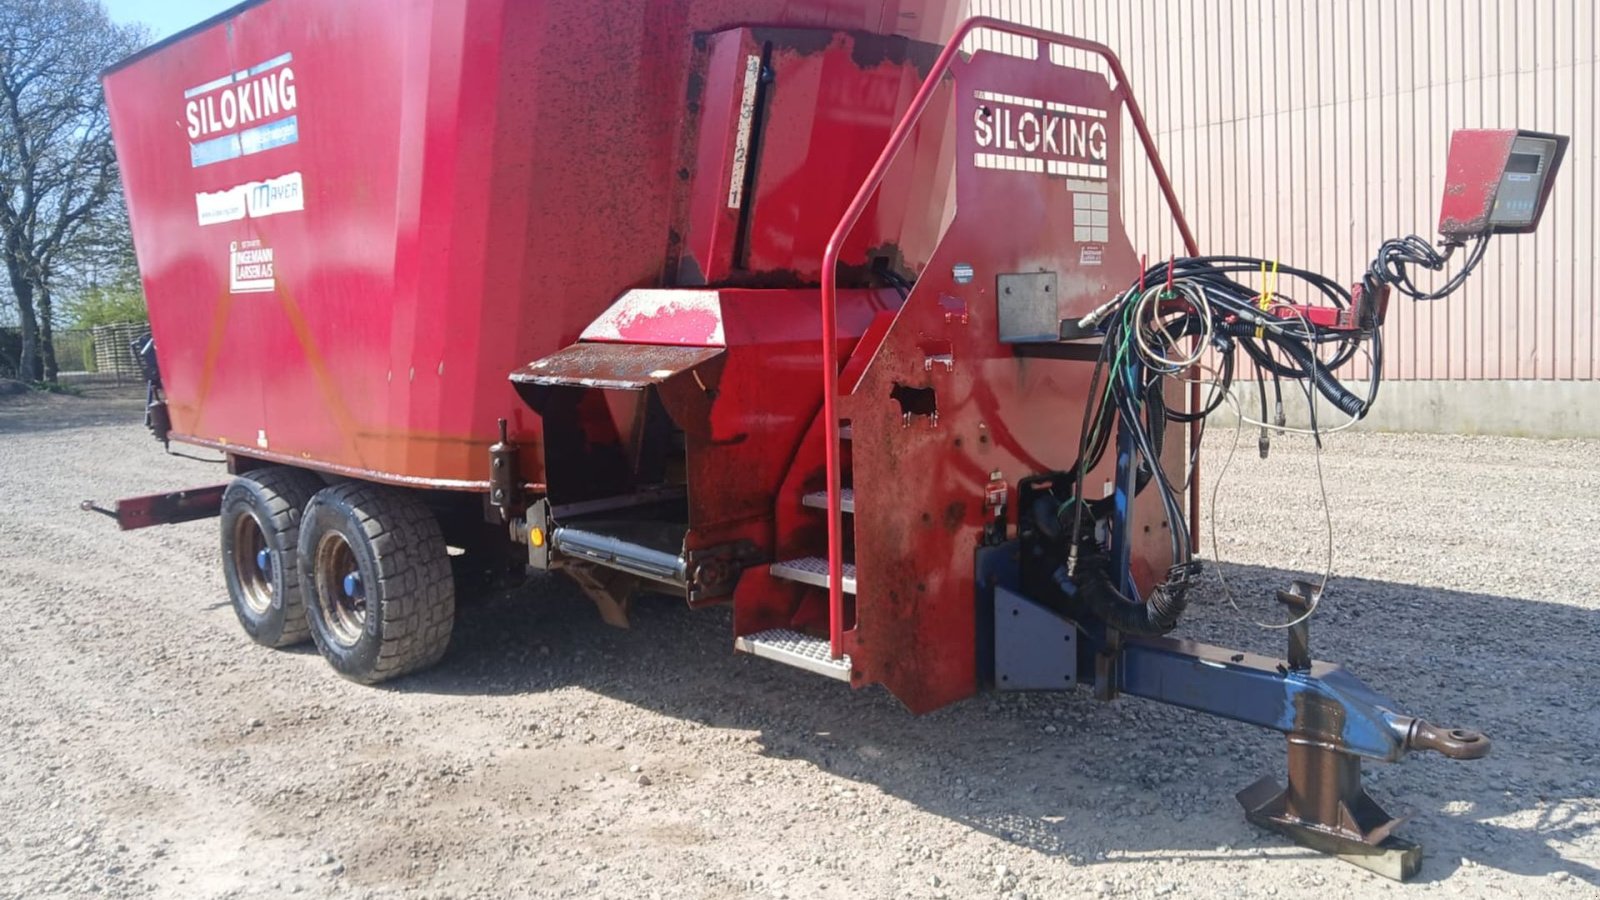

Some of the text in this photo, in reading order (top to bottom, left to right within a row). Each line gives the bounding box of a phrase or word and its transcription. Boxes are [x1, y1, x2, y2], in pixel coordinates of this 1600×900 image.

[186, 67, 297, 139] SILOKING
[974, 104, 1107, 161] SILOKING
[735, 147, 745, 162] 2
[253, 182, 299, 211] MAYER
[731, 190, 737, 205] 1
